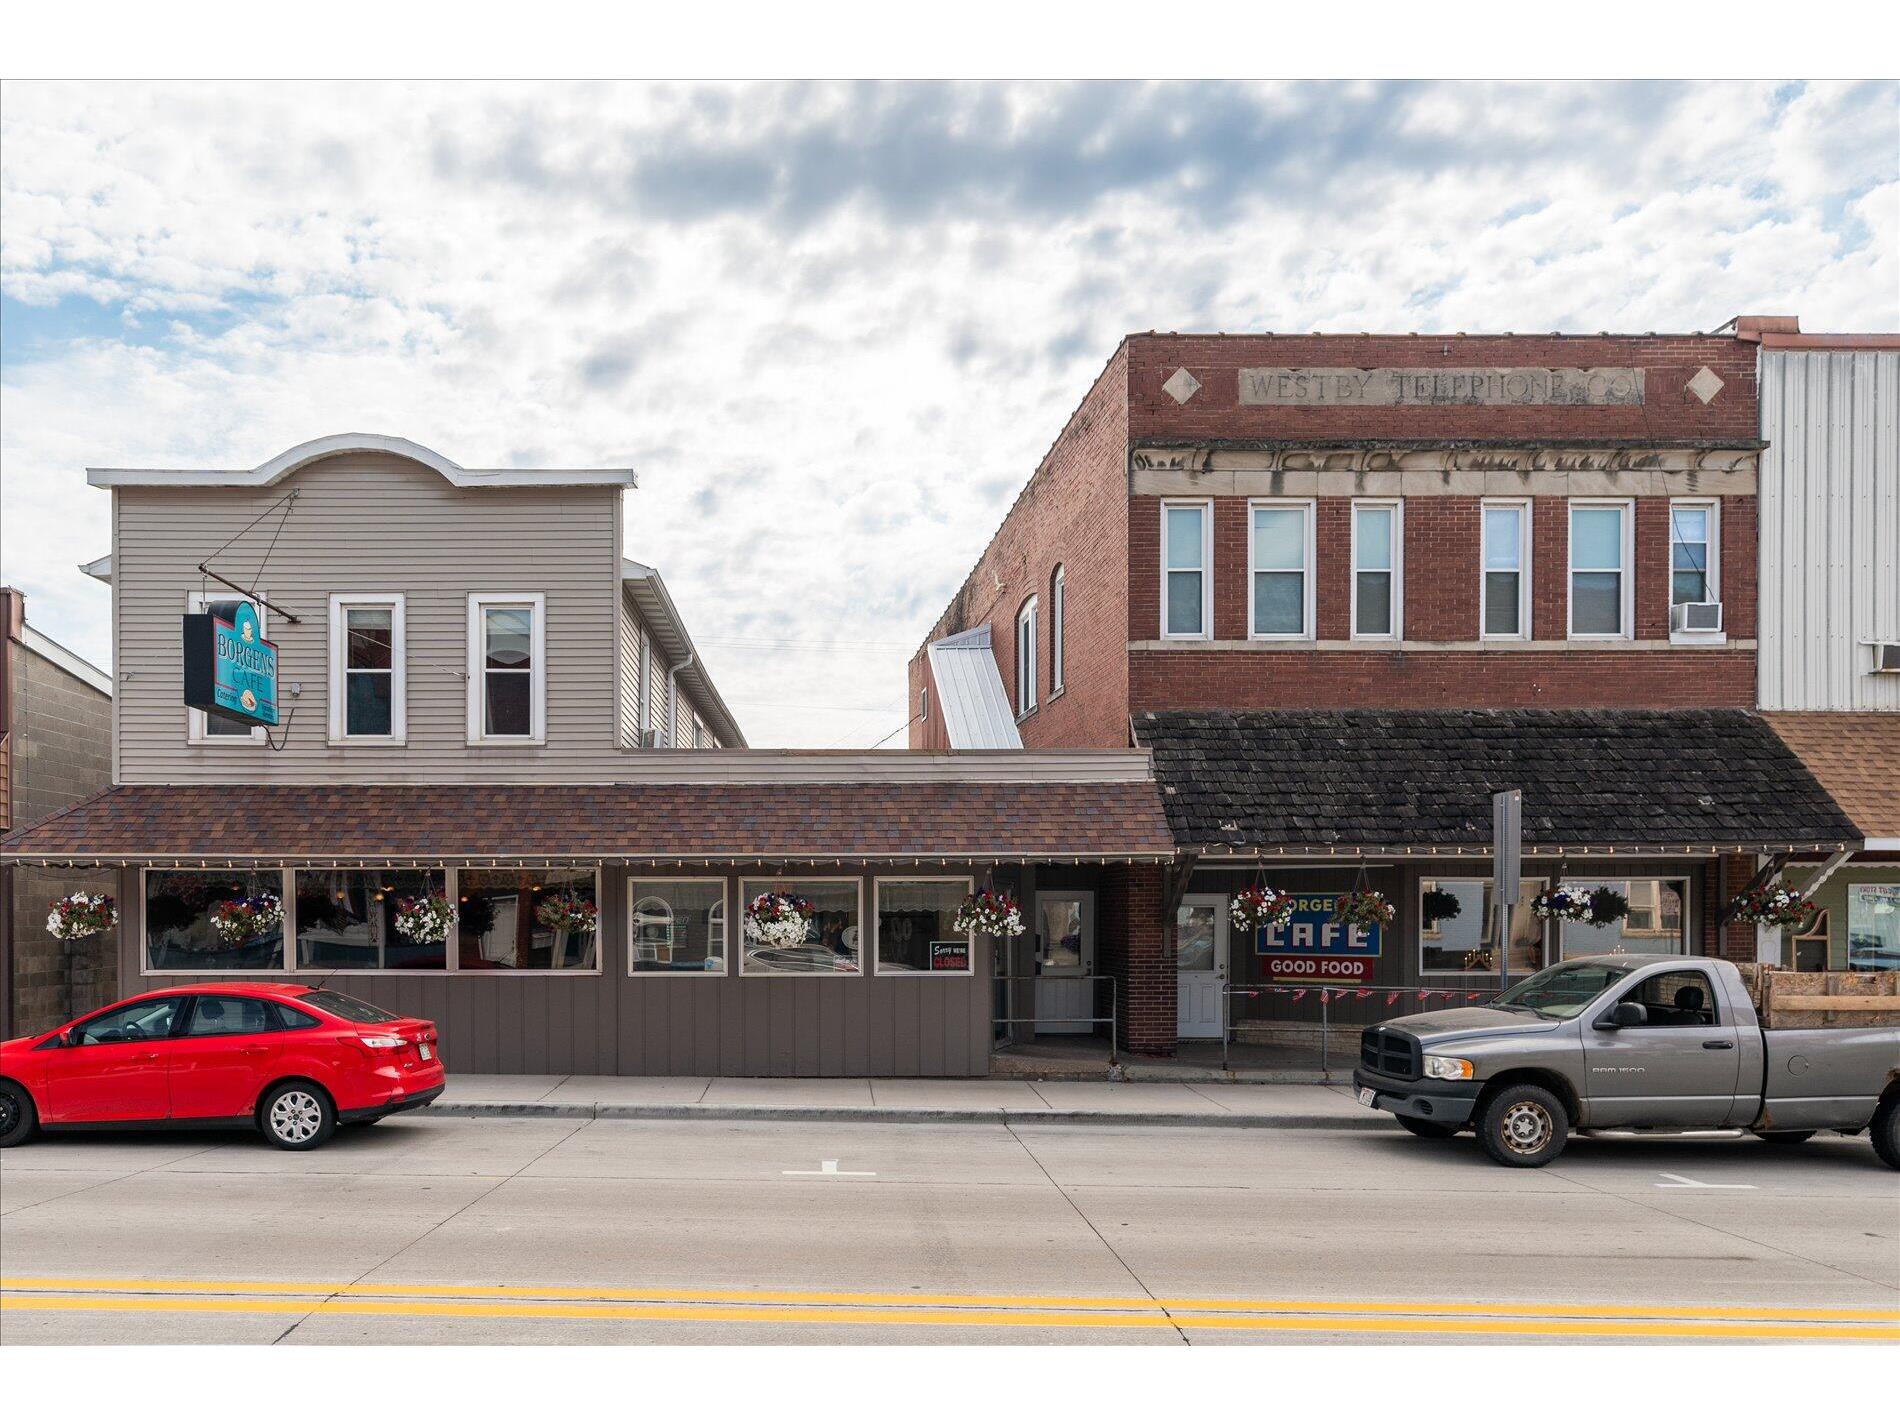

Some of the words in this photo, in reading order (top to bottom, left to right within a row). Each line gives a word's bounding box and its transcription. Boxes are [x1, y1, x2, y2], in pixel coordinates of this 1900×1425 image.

[1250, 374, 1372, 398] WESTBY
[1392, 374, 1568, 399] TELEPHONE
[232, 667, 263, 692] CAFE
[1266, 922, 1368, 947] CAFE
[934, 957, 967, 968] CLOSED
[1270, 960, 1316, 973] GOOD
[1321, 961, 1364, 975] FOOD
